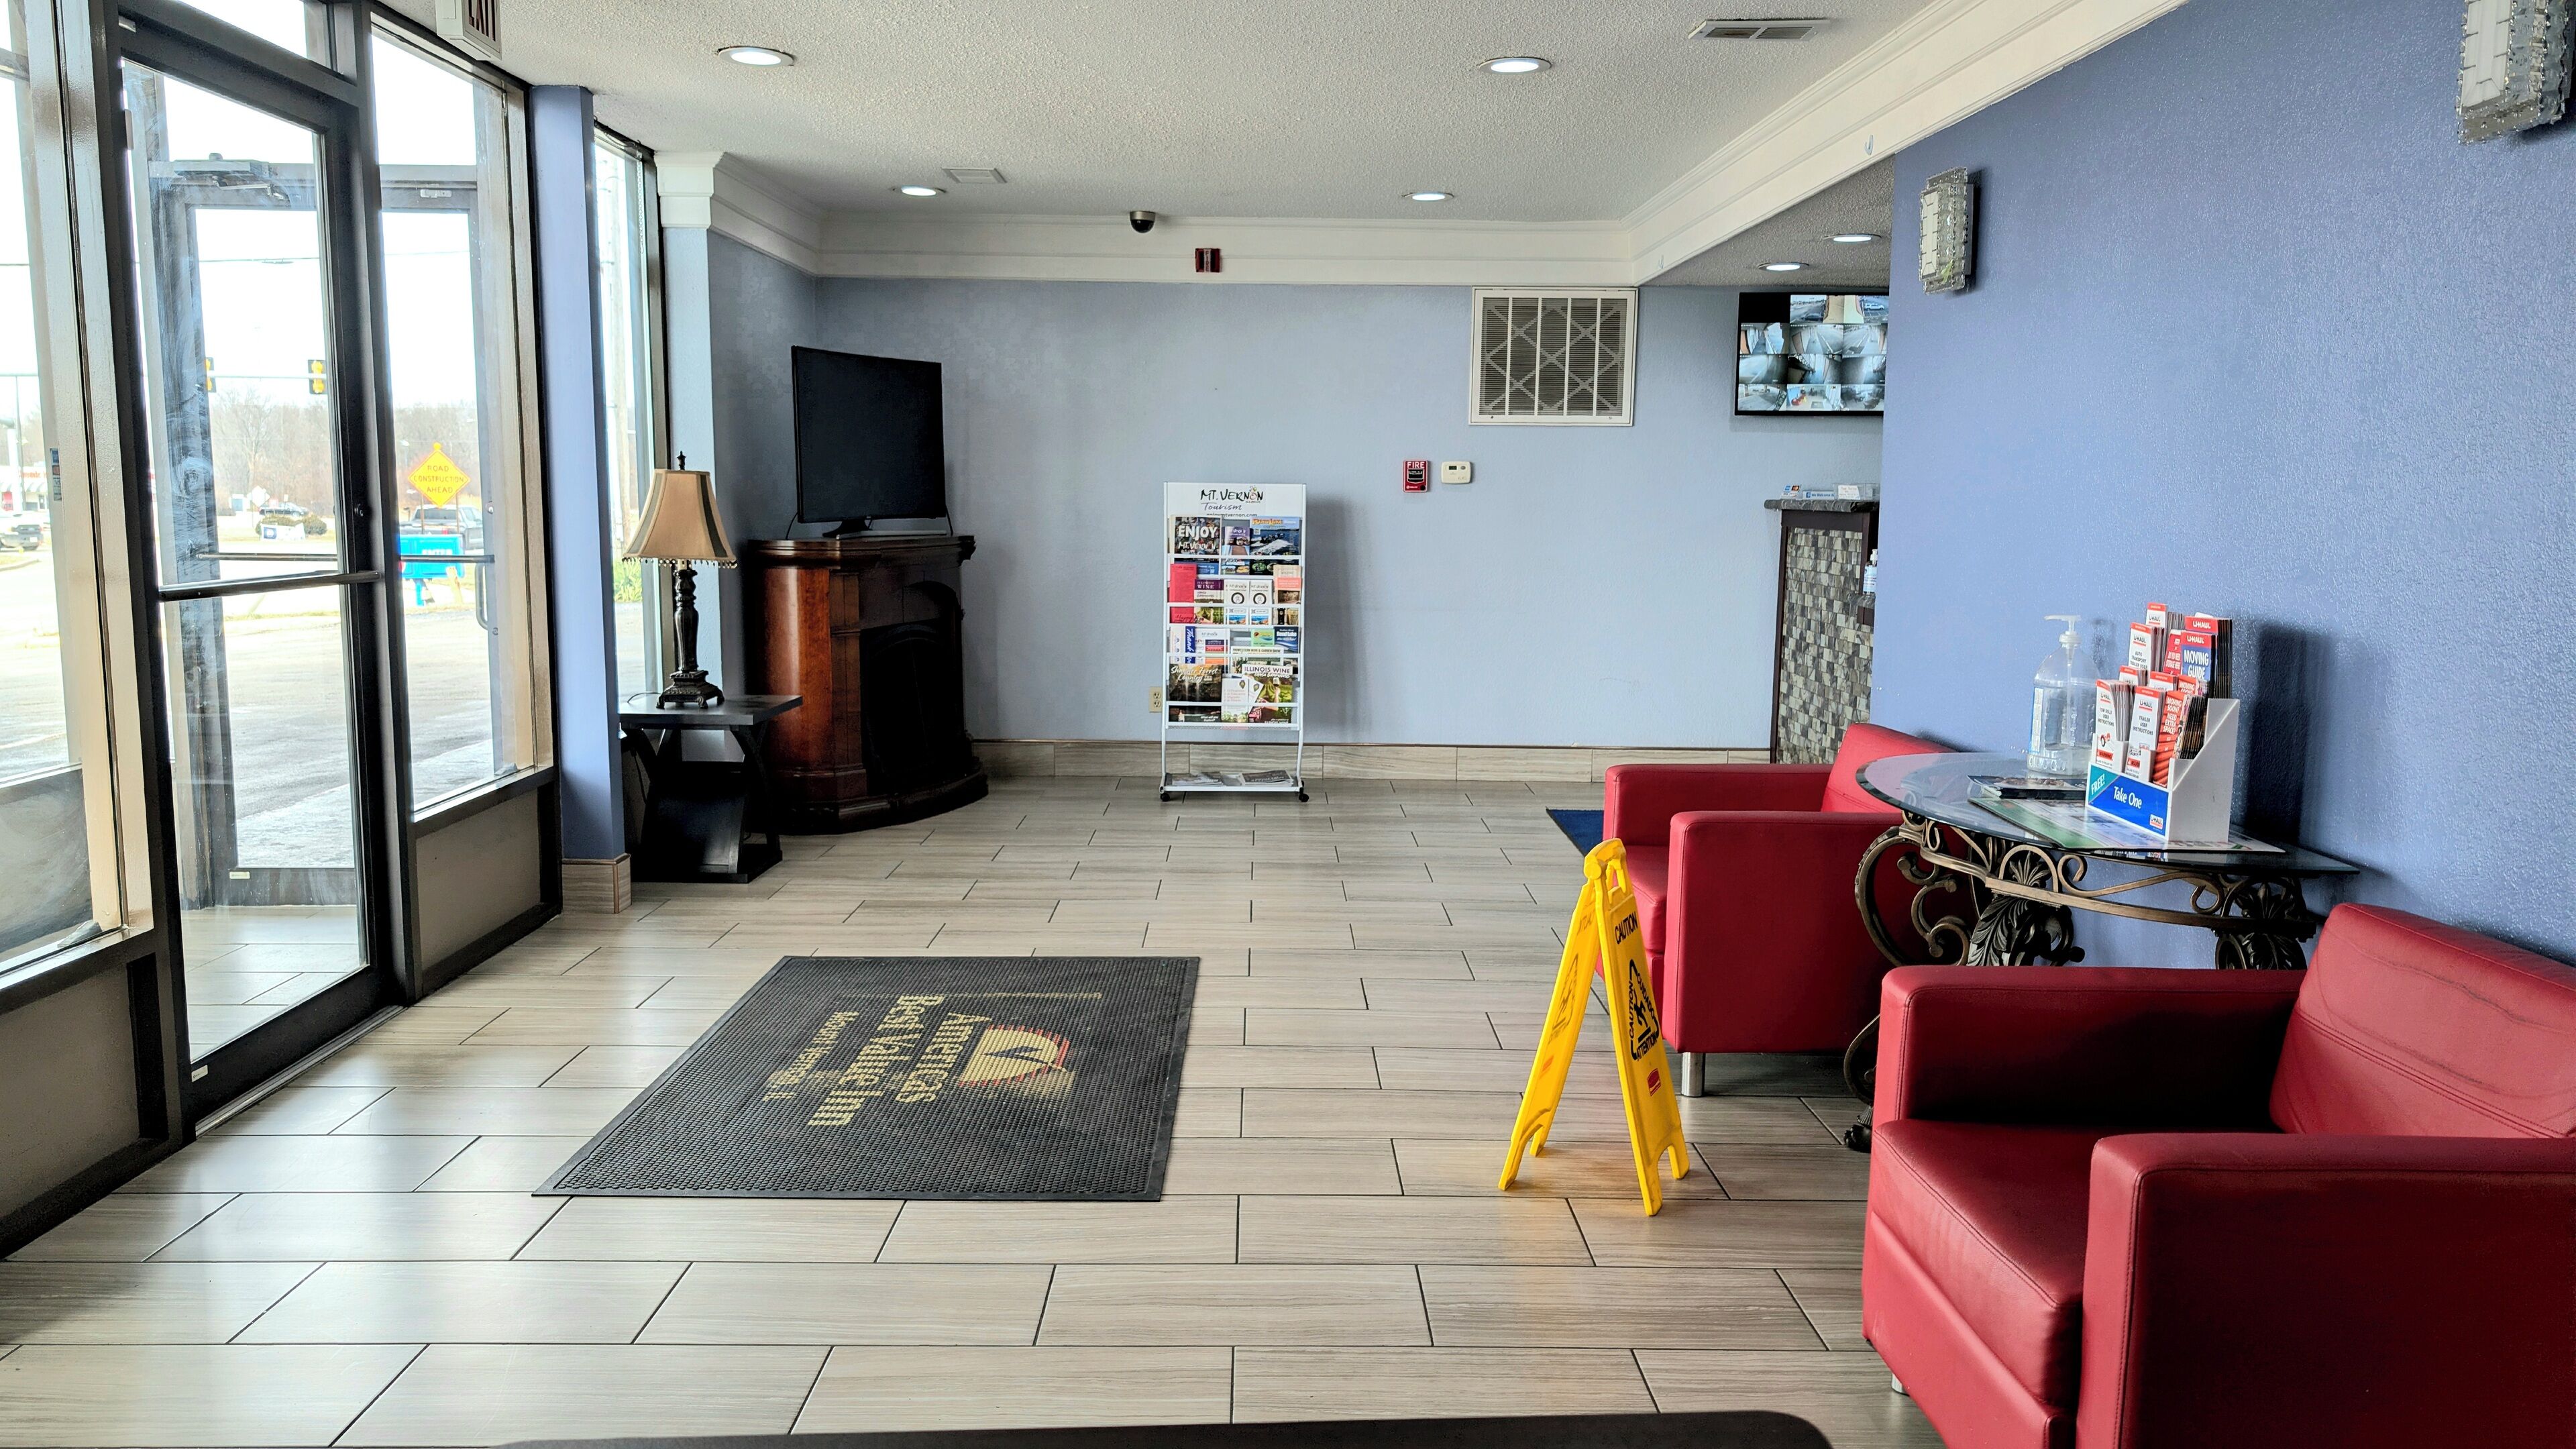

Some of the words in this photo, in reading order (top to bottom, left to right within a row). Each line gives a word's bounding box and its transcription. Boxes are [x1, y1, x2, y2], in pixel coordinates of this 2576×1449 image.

[1201, 489, 1218, 500] MT.
[1220, 488, 1263, 502] VERNON
[1201, 502, 1242, 511] Tourism
[1179, 525, 1217, 541] ENJOY
[2184, 649, 2208, 665] MOVING
[1177, 674, 1203, 684] Country
[2188, 665, 2205, 680] GUIDE
[2180, 681, 2195, 690] MOVING
[2167, 698, 2182, 706] MOVING
[2098, 718, 2114, 727] INSTRUCTIONS
[2133, 726, 2153, 735] INSTRUCTIONS
[2165, 719, 2176, 727] EXTRA
[2091, 773, 2105, 795] FREE!
[2114, 786, 2127, 803] Take
[2129, 792, 2142, 809] One
[1615, 911, 1638, 945] CAUTION
[1637, 973, 1655, 1020] CUIDADO
[877, 994, 945, 1031] Best
[811, 1011, 859, 1044] Mount
[1637, 1031, 1657, 1061] ATTENTION
[839, 1033, 922, 1086] Value
[895, 1012, 993, 1103] Americas
[808, 1091, 885, 1126] Inn
